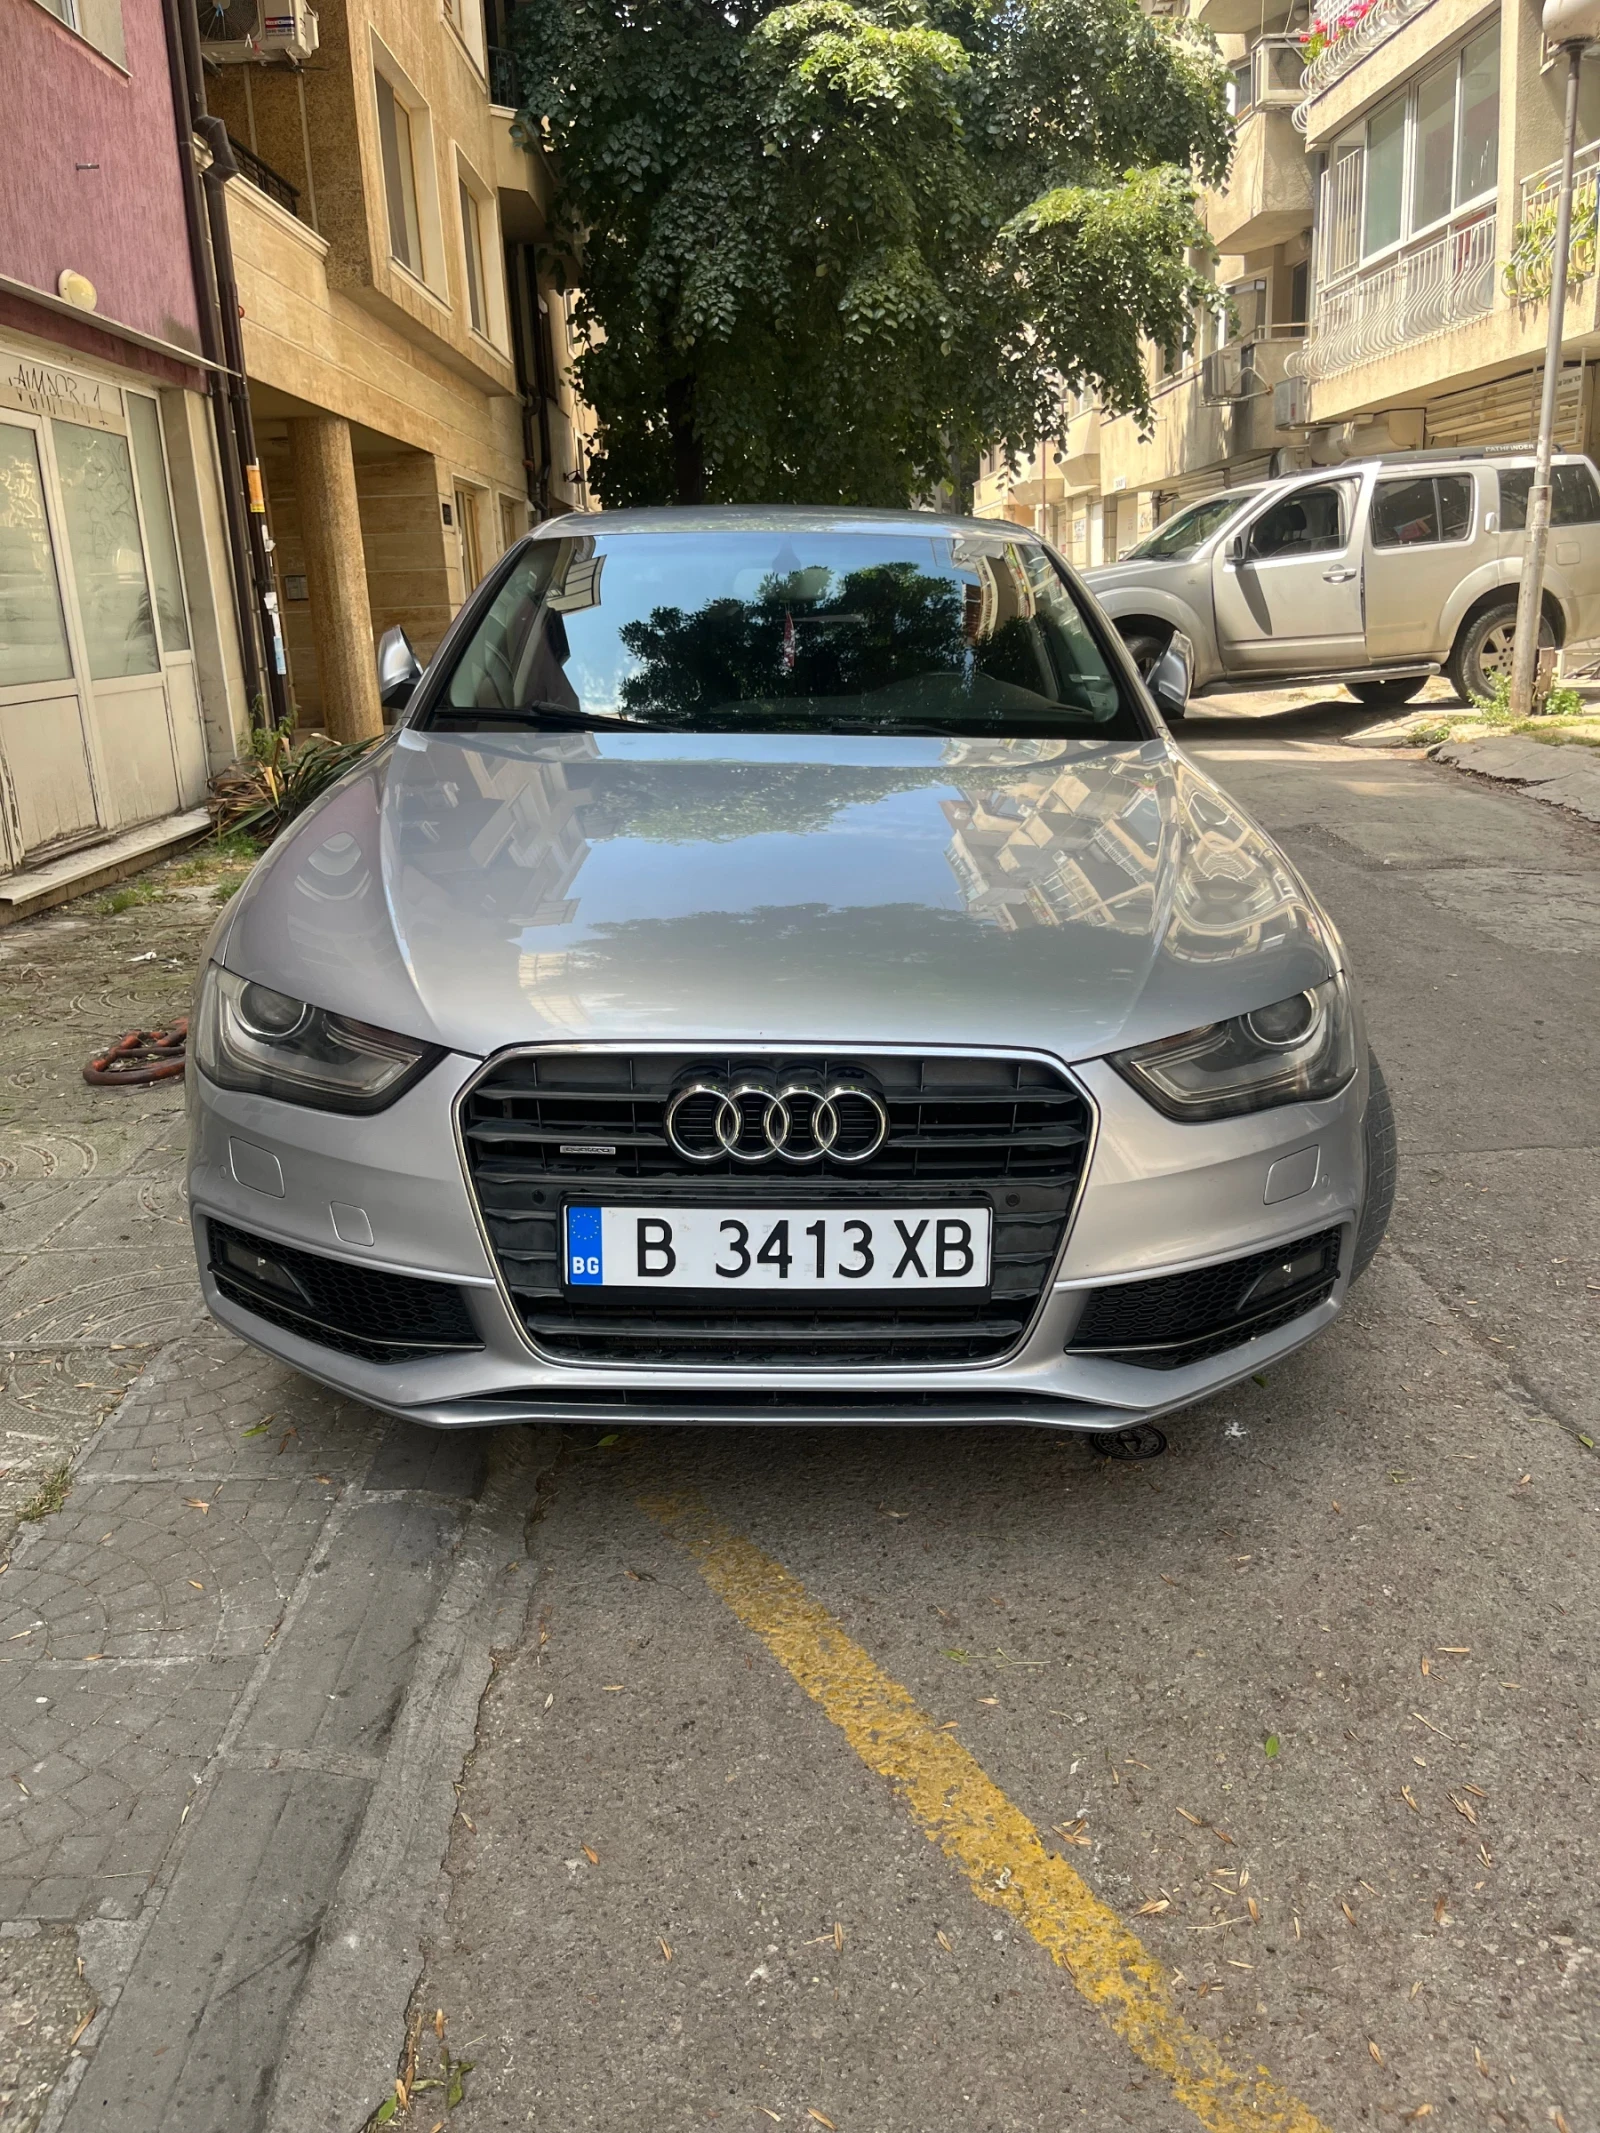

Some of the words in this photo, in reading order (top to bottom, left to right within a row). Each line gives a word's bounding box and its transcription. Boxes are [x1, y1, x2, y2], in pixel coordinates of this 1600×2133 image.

[1485, 443, 1534, 452] PATHFINDER
[636, 1218, 676, 1278] B
[715, 1219, 875, 1279] 3413
[892, 1219, 975, 1279] XB
[572, 1256, 600, 1275] BG
